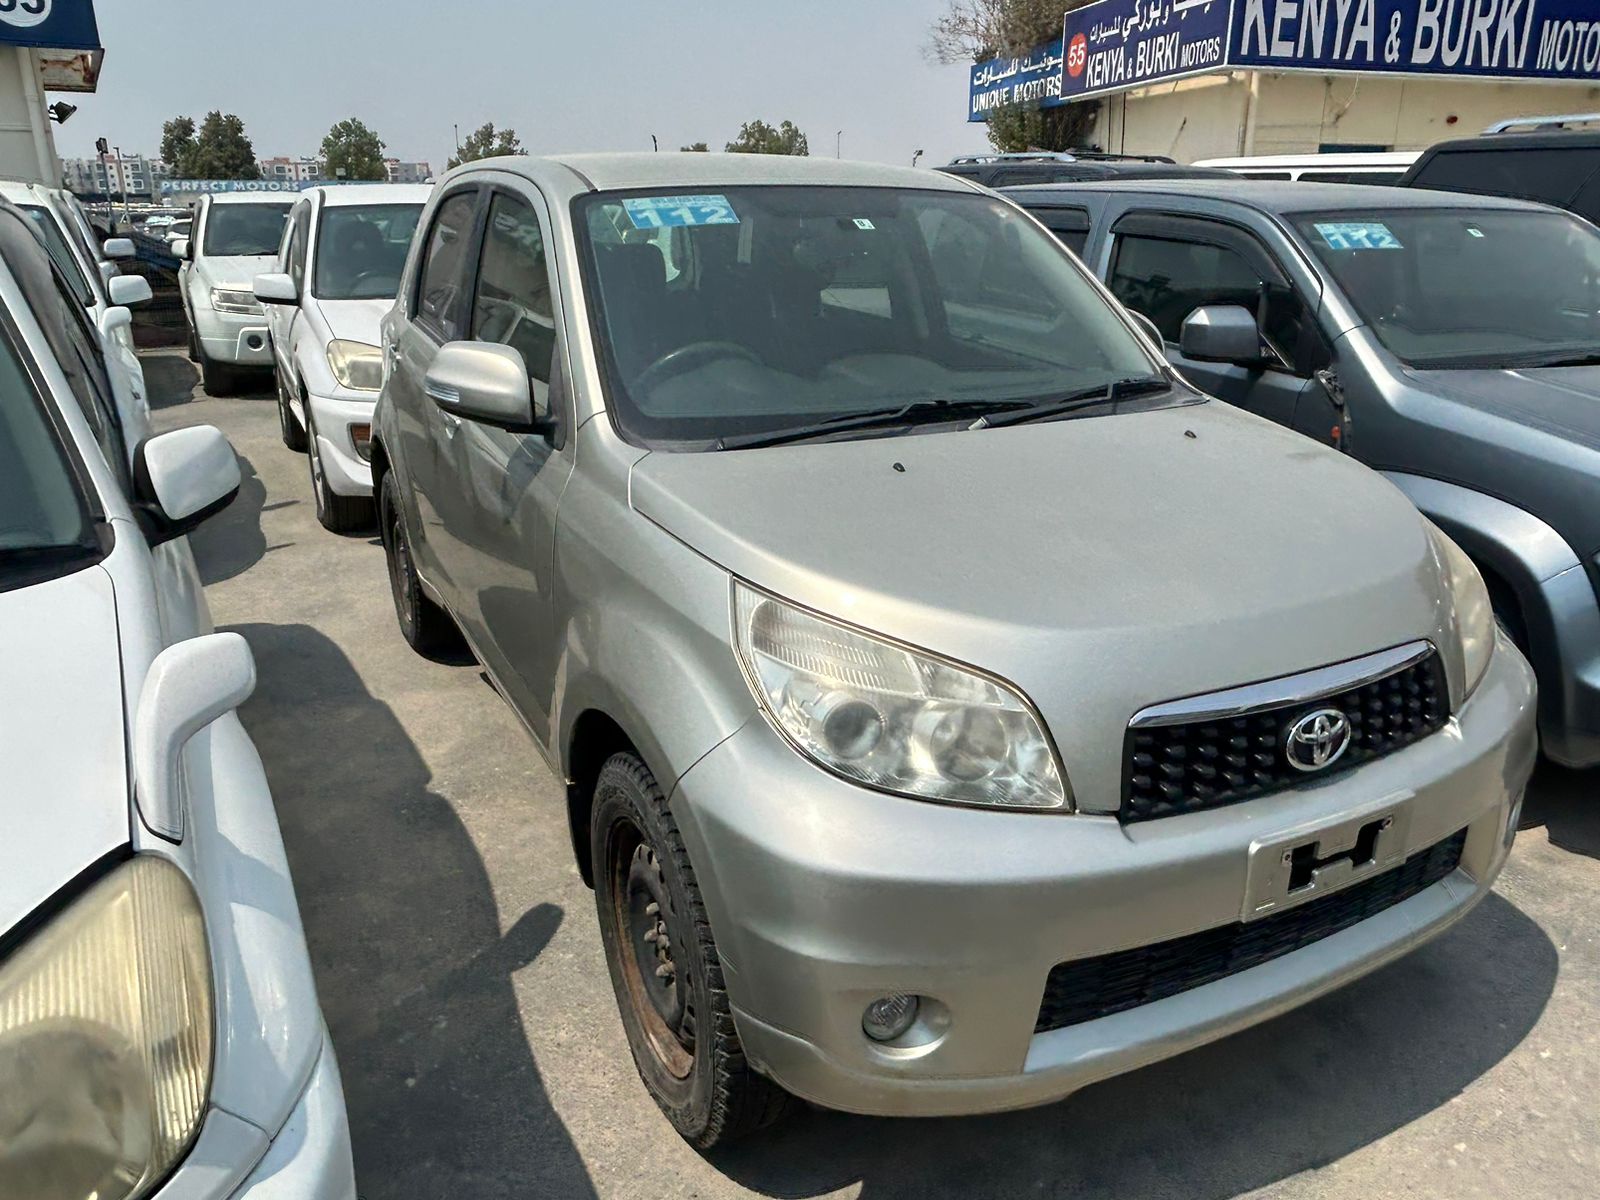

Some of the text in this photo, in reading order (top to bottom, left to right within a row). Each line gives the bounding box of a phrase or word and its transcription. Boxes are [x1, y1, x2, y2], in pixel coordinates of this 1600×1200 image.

[1240, 0, 1600, 73] KENYA & BURKI MOTO
[1068, 43, 1086, 67] 55
[1086, 32, 1221, 88] KENYA & BURKI MOTORS
[973, 58, 1018, 87] للسيارات
[972, 73, 1062, 113] UNIQUE MOTORS
[161, 180, 228, 192] PERFECT
[232, 180, 299, 191] MOTORS
[636, 205, 735, 228] 112
